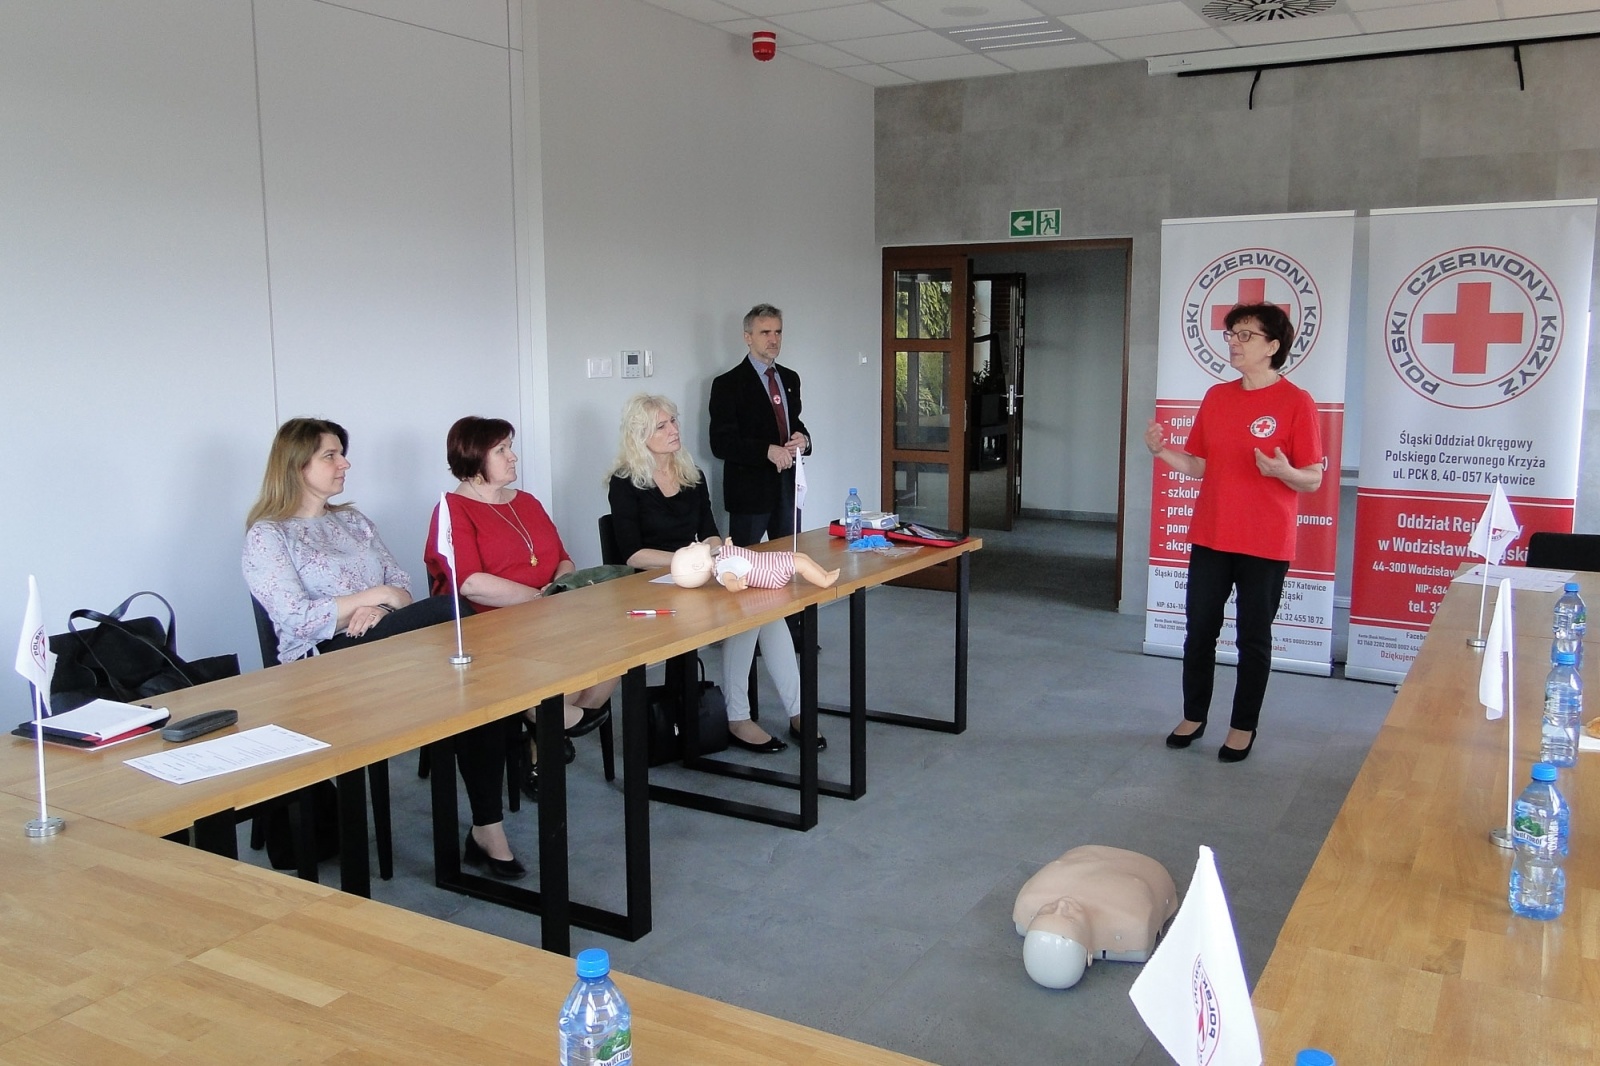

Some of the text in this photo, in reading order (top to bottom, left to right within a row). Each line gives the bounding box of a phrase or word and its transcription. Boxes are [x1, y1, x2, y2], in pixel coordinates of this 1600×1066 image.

[1199, 252, 1313, 296] CZERWONY
[1390, 252, 1557, 396] POLSKI CZERWONY KRZYŻ
[1186, 303, 1226, 374] POLSKI
[1170, 432, 1188, 445] kur
[1399, 430, 1533, 452] Śląski Oddział Okręgowy
[1385, 450, 1546, 470] Polskiego Czerwonego Krzyża
[1393, 468, 1405, 480] ul.
[1407, 468, 1429, 481] PCK
[1442, 471, 1482, 483] 40-057
[1484, 473, 1536, 486] Katowice
[1167, 486, 1200, 499] szkoln
[1167, 504, 1194, 518] prele
[1166, 514, 1333, 536] pom pomoc
[1397, 512, 1450, 530] Oddział
[1378, 540, 1389, 551] w
[1372, 561, 1406, 574] 44-300
[1174, 580, 1187, 590] Odd
[1296, 582, 1327, 592] Katowice
[1415, 583, 1448, 595] NIP: 634
[1408, 600, 1427, 614] tel.
[1284, 613, 1293, 621] 32
[1315, 616, 1324, 624] 72
[1380, 650, 1416, 662] Dziękujem
